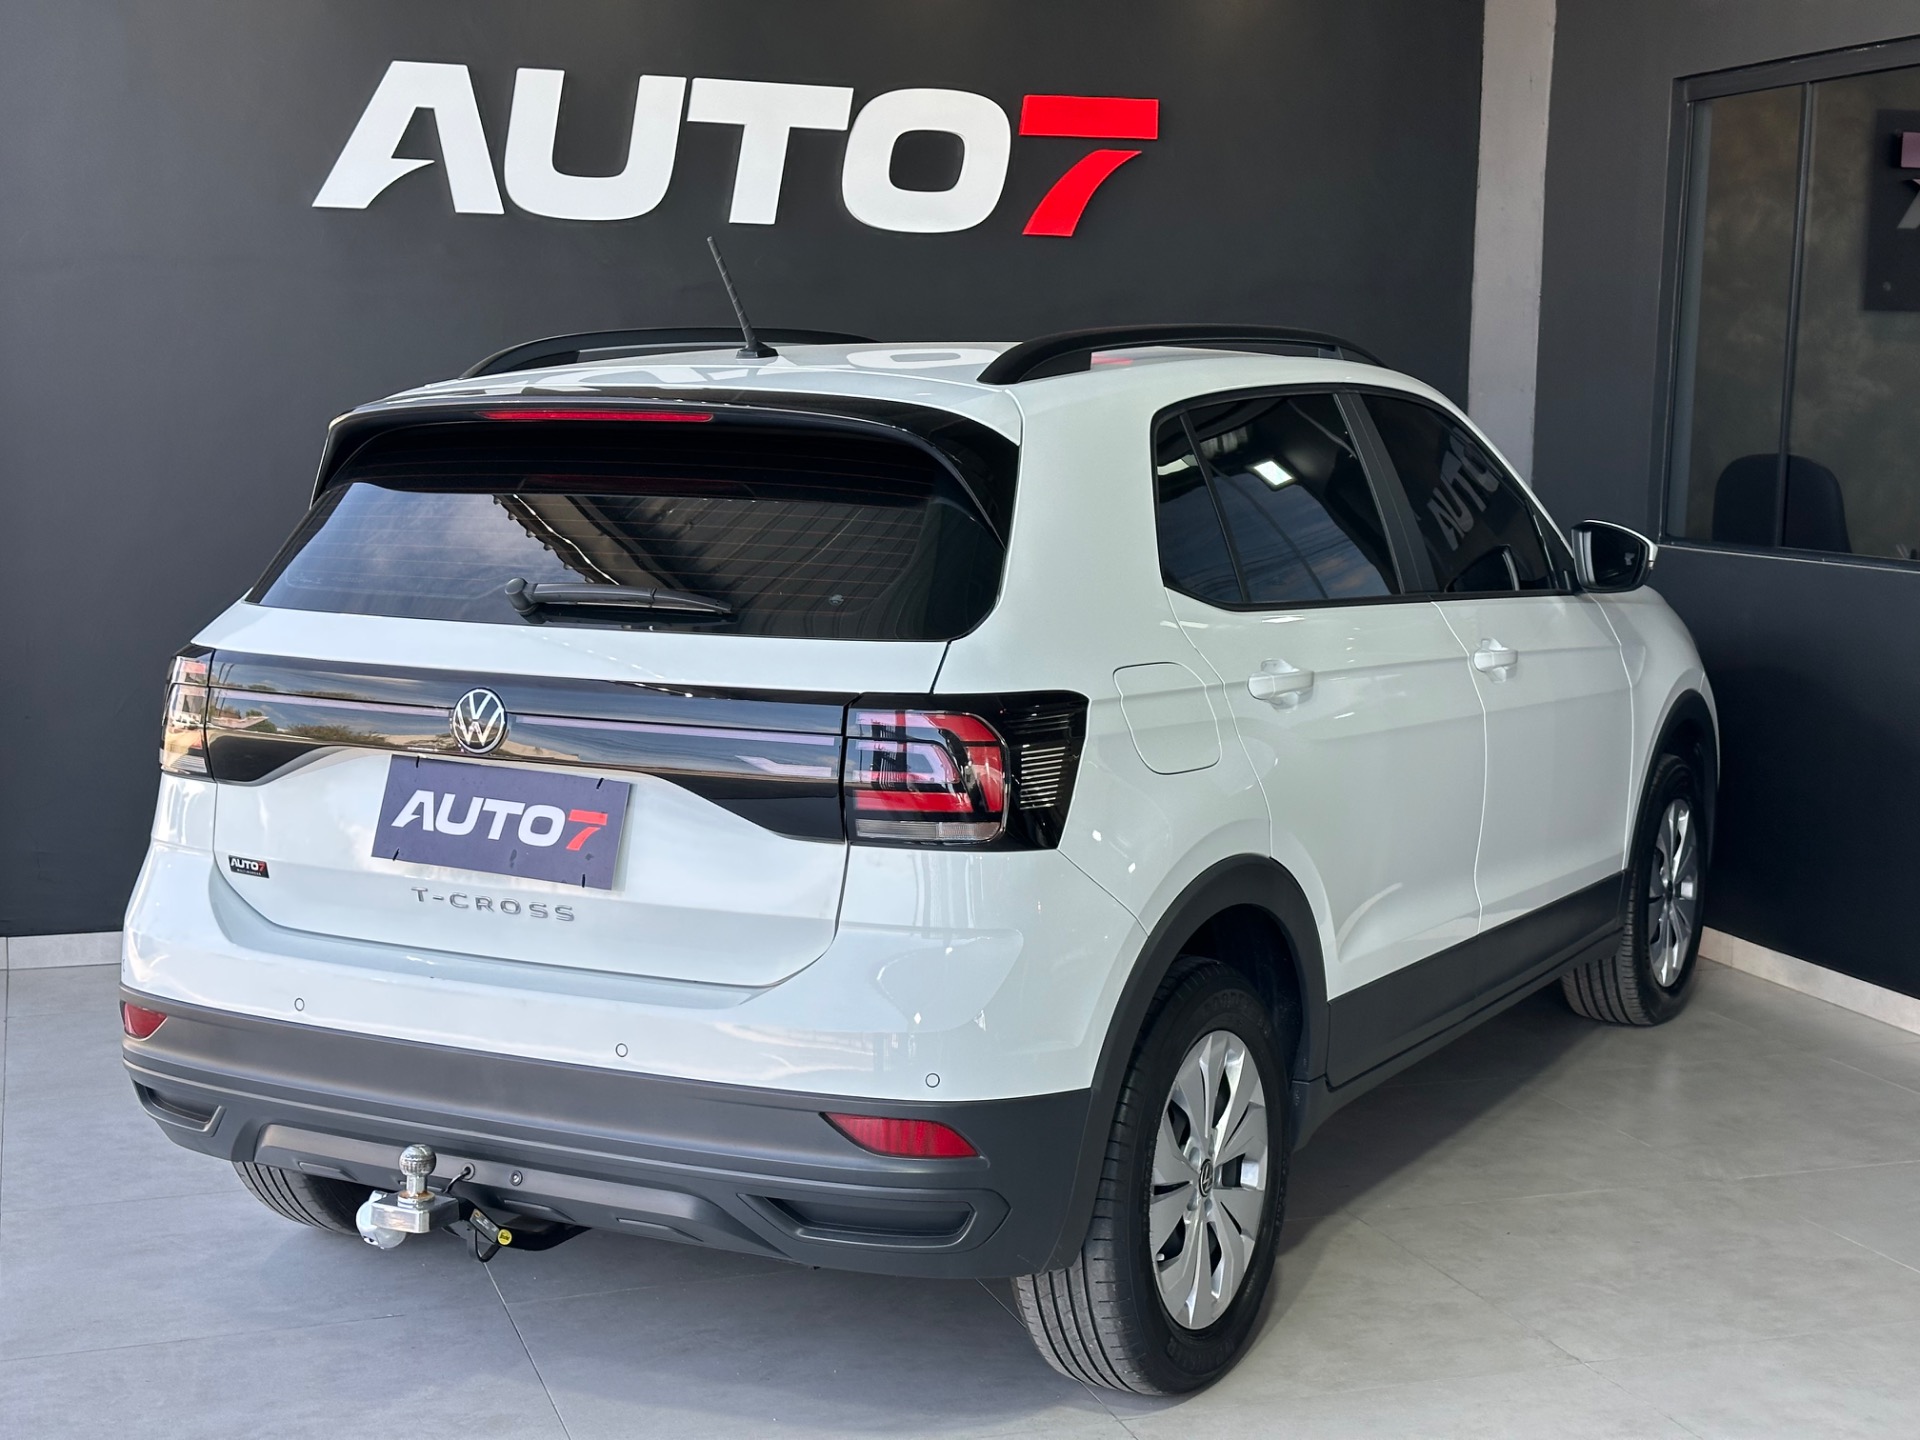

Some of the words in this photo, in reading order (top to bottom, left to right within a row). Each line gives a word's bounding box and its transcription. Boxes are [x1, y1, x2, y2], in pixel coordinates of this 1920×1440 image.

[312, 60, 1159, 236] AUTO7
[453, 688, 505, 753] VW
[391, 789, 608, 851] AUTO7
[230, 857, 266, 872] AUTO7
[411, 886, 575, 922] T-CROSS
